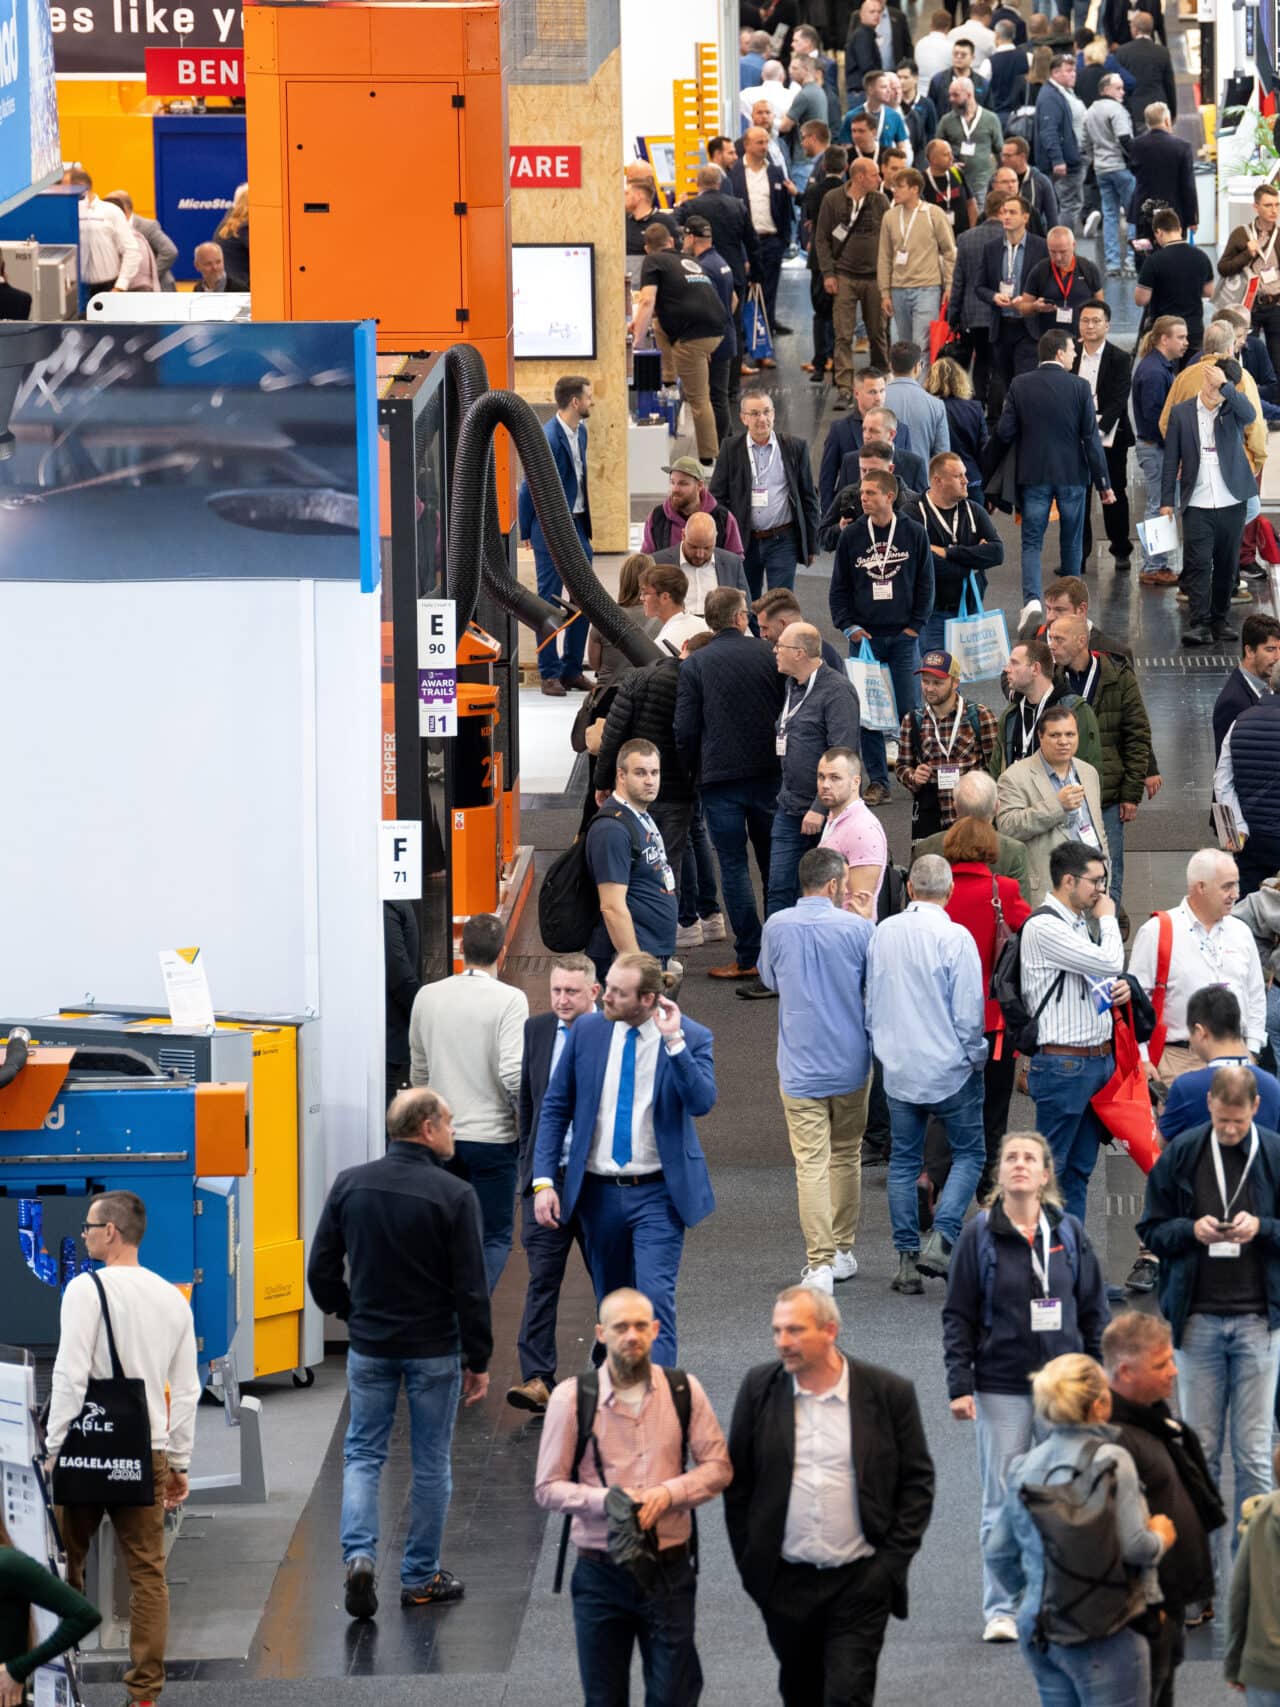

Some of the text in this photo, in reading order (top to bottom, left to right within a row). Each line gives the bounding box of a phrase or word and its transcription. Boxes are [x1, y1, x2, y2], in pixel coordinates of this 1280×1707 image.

[113, 0, 195, 33] like
[212, 8, 244, 43] y
[178, 60, 246, 85] BEN
[430, 614, 444, 636] E
[428, 643, 446, 655] 90
[421, 679, 455, 688] AWARD
[421, 687, 455, 697] TRAILS
[383, 732, 397, 795] KEMPER
[393, 837, 408, 862] F
[393, 871, 408, 883] 71
[59, 1456, 142, 1470] EAGLELASERS
